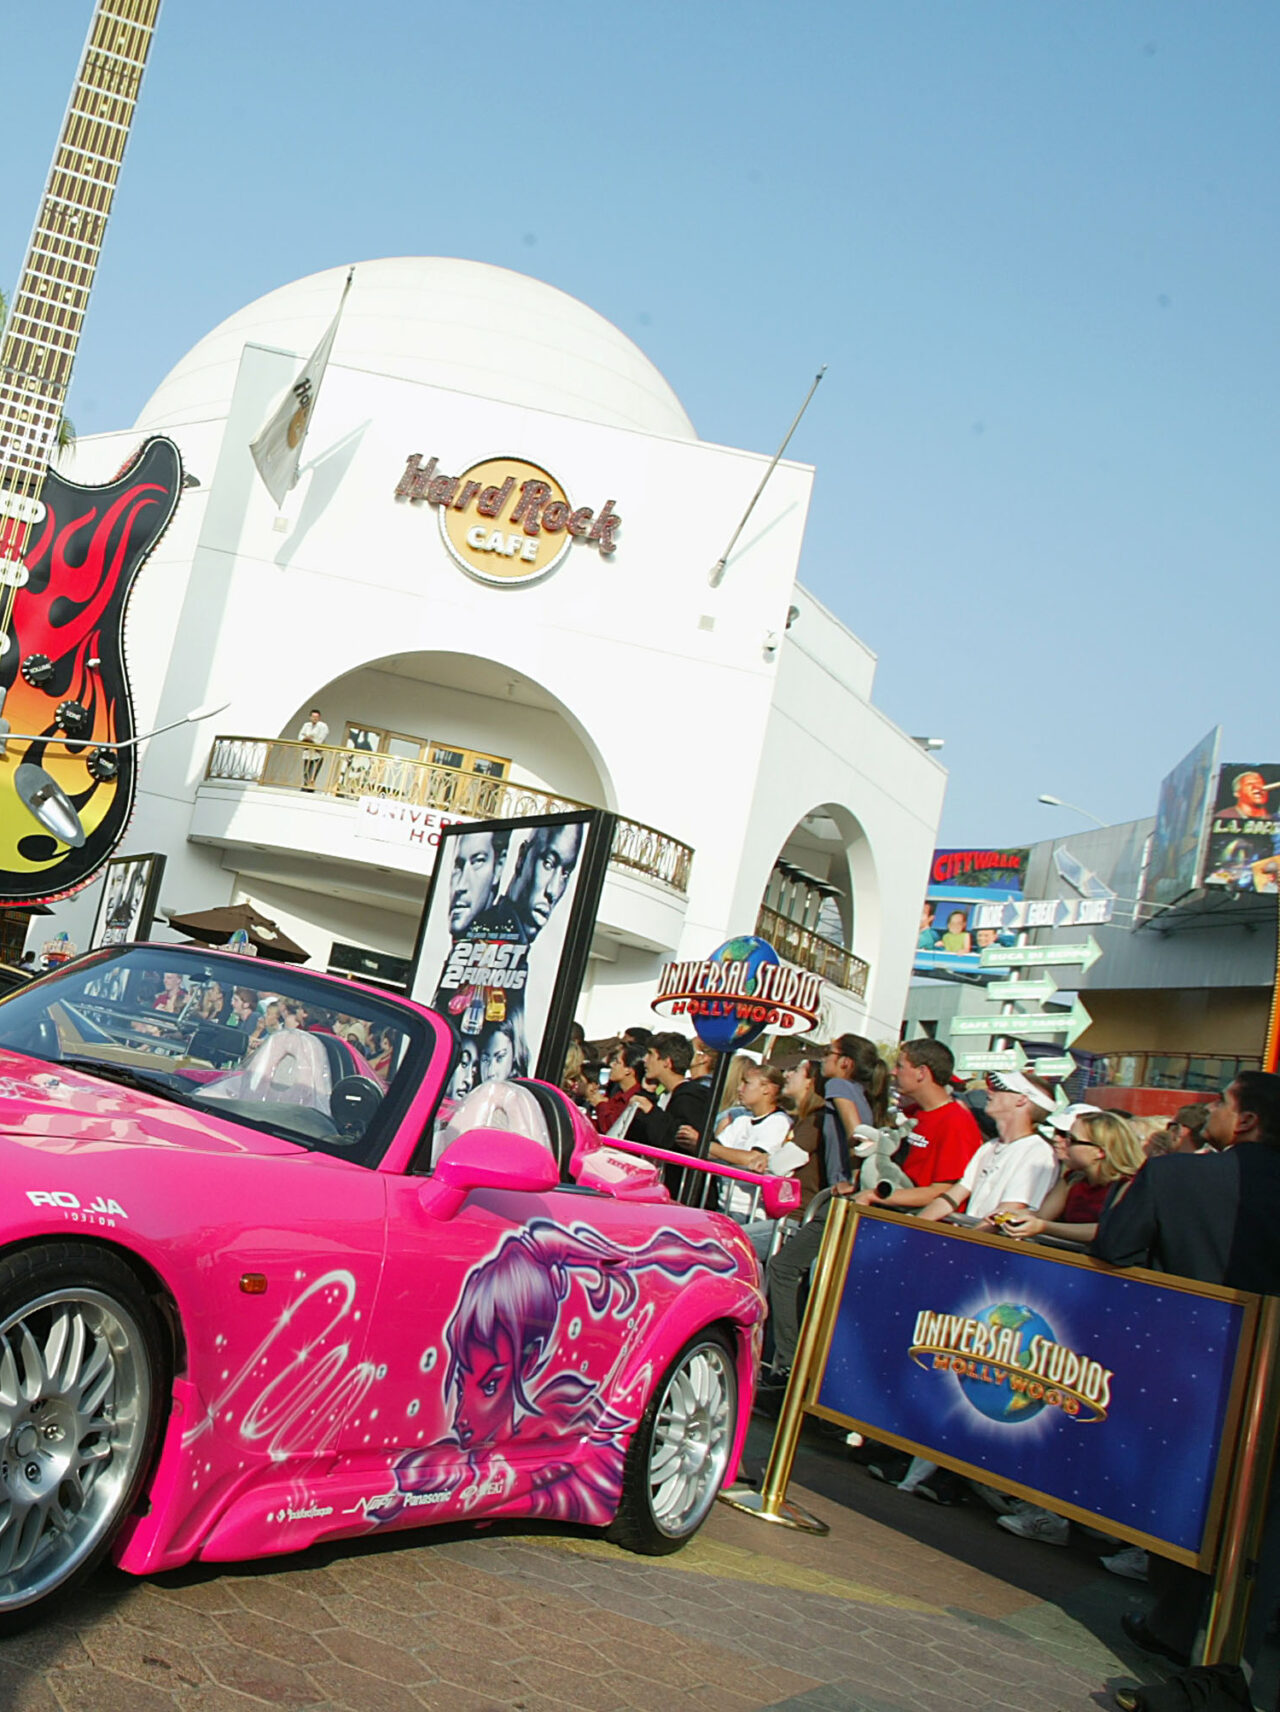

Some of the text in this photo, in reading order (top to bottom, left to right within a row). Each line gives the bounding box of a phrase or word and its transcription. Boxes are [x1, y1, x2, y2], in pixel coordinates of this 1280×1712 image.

[393, 453, 623, 554] Hard Rock
[465, 524, 541, 563] CAFE
[932, 850, 1021, 882] CITYWALK
[657, 960, 751, 997] UNIVERSAL
[671, 999, 796, 1029] HOLLYWOOD
[912, 1309, 1115, 1408] UNIVERSAL STUDIOS
[932, 1353, 1081, 1416] HOLLYWOOD
[403, 1487, 453, 1508] Panasonic
